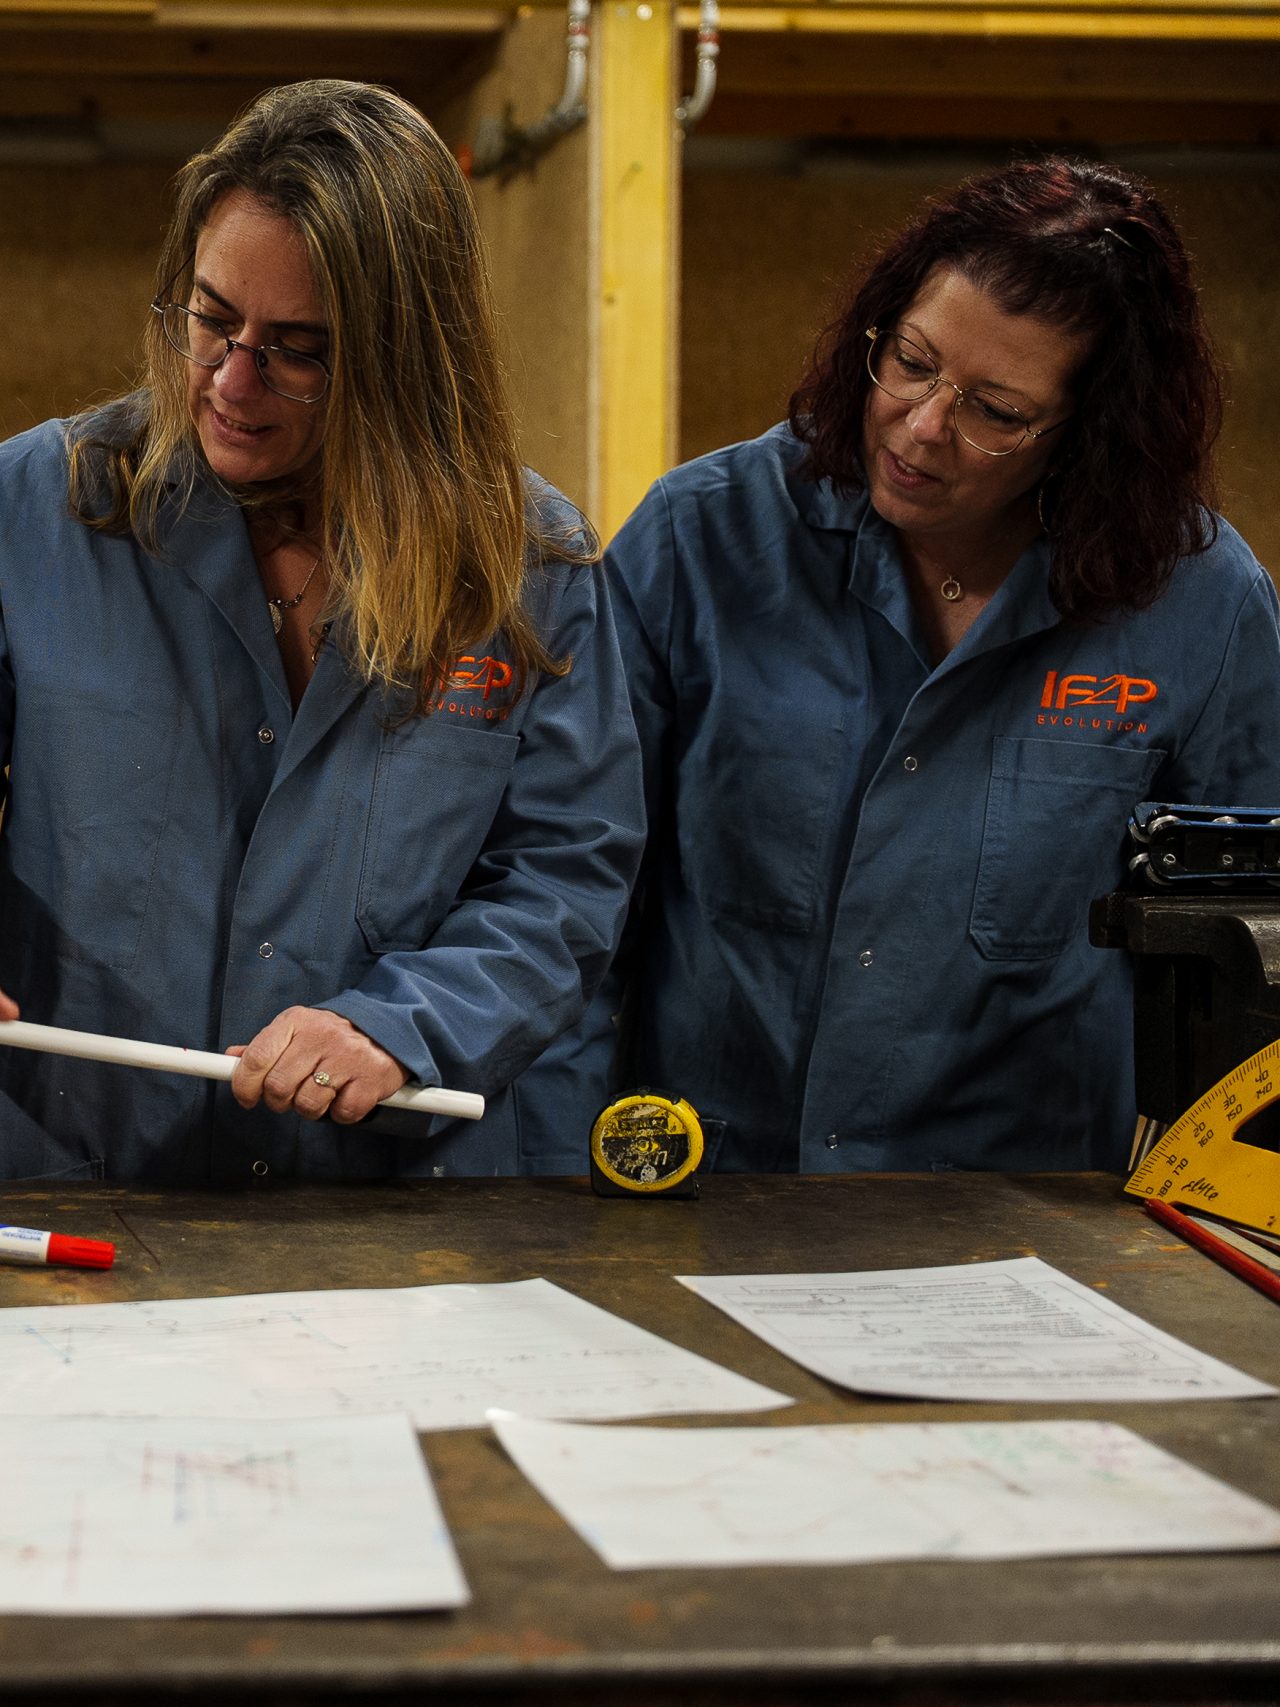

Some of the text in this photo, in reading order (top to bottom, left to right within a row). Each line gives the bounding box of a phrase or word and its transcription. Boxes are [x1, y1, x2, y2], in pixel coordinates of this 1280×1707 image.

[1039, 670, 1159, 714] IF2P
[1036, 714, 1148, 734] EVOLUTION
[1255, 1070, 1269, 1083] 40
[1256, 1082, 1273, 1099] 140
[1223, 1094, 1236, 1110] 30
[1227, 1103, 1243, 1122] 150
[1193, 1121, 1206, 1138] 20
[1198, 1129, 1214, 1148] 160
[1166, 1154, 1177, 1166] 10
[1172, 1158, 1189, 1176] 170
[1145, 1186, 1154, 1196] 0
[1157, 1179, 1173, 1198] 180
